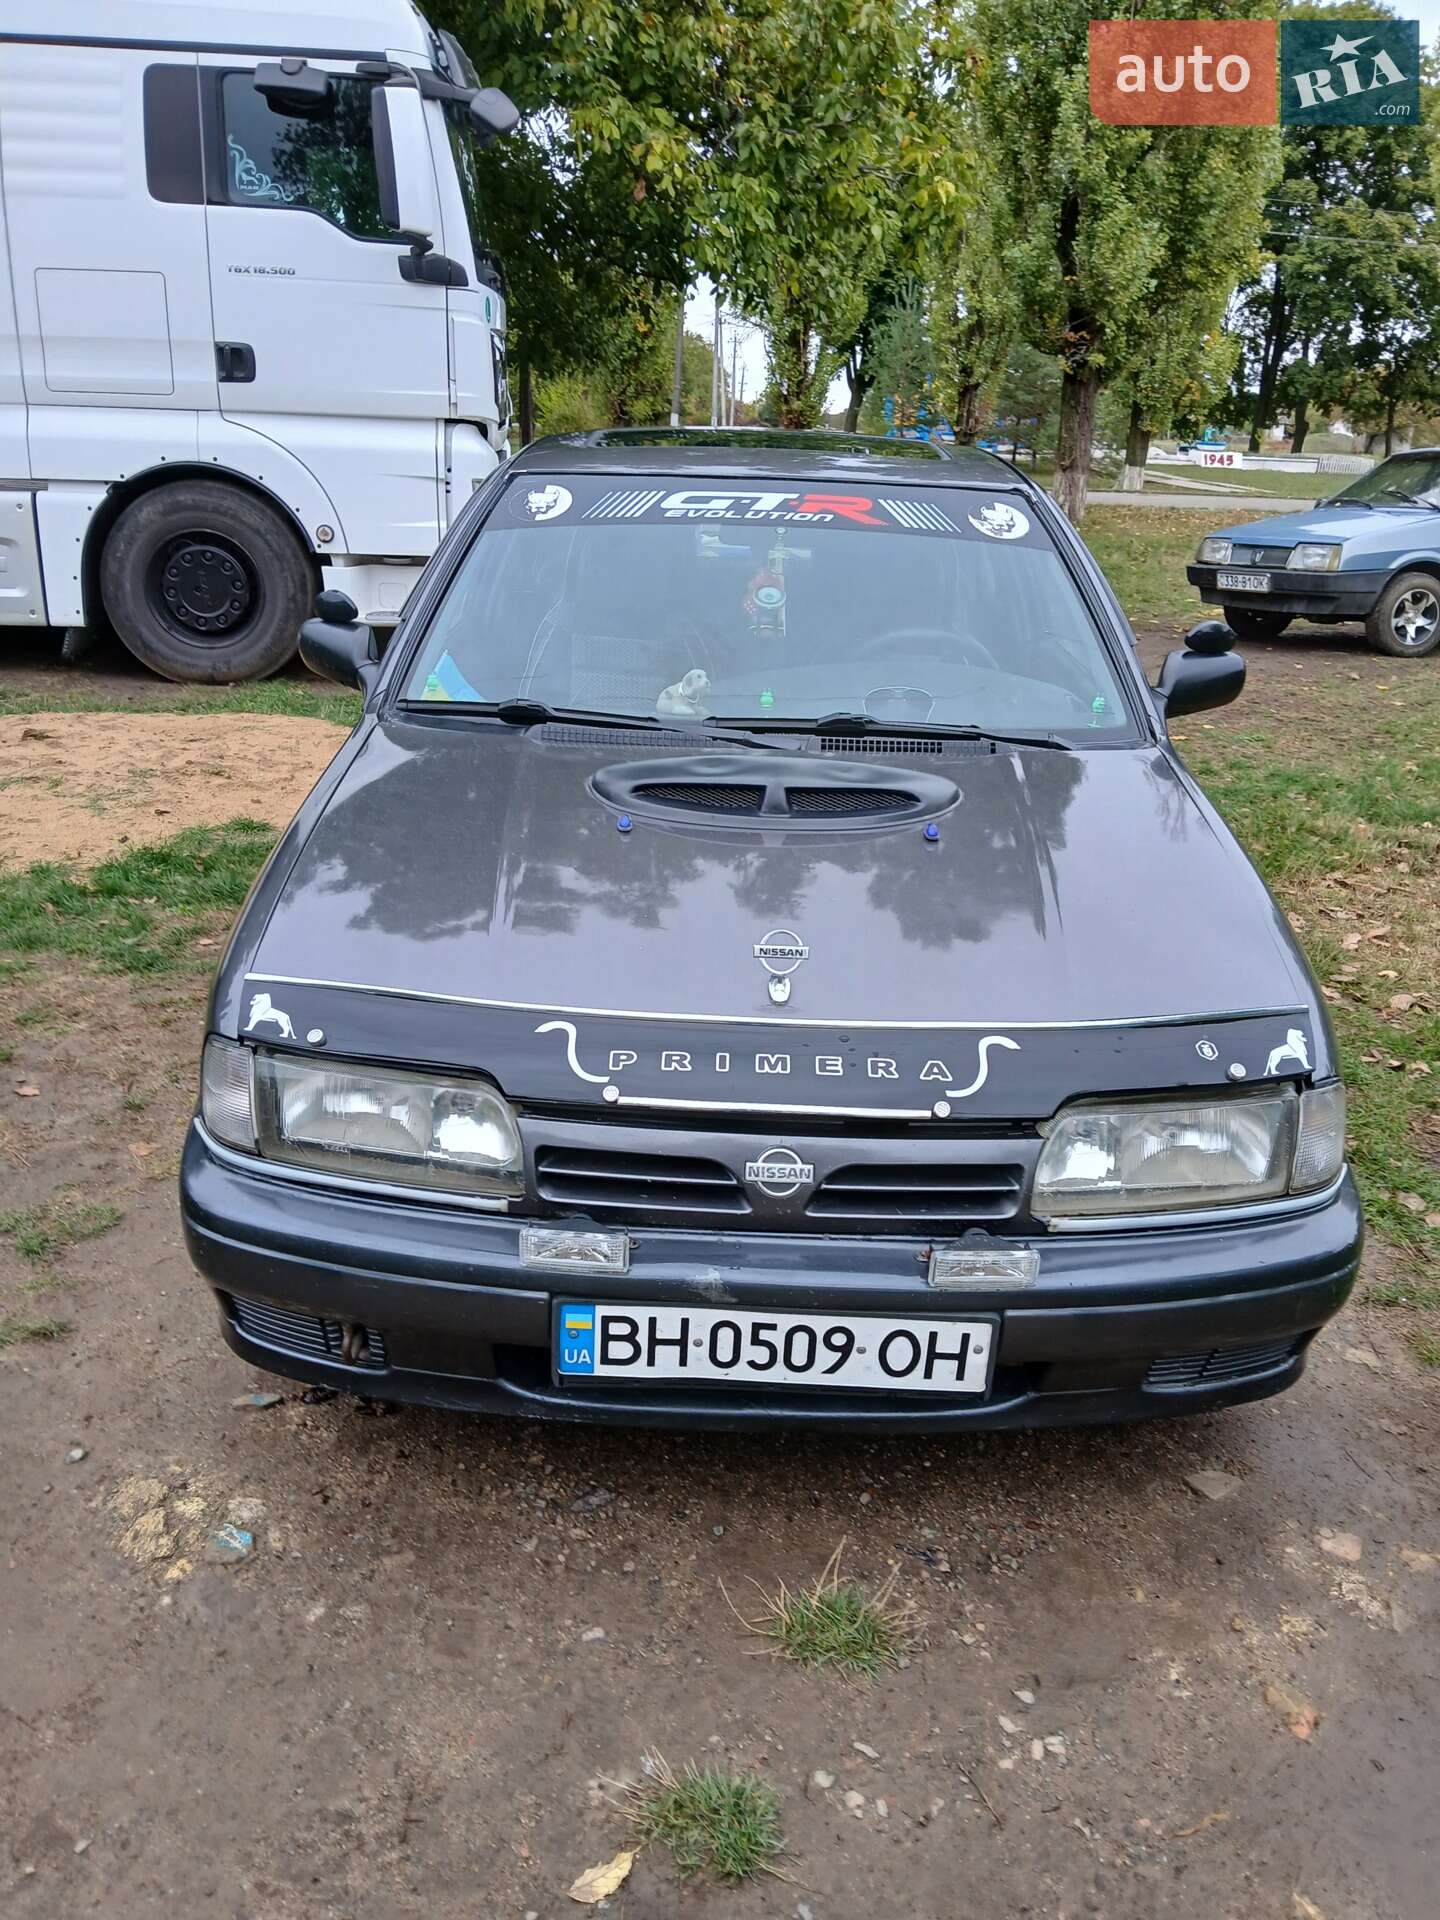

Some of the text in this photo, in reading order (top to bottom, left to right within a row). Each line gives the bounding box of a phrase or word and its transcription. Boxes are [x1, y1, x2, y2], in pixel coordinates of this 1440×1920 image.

[1204, 453, 1234, 467] 1945
[759, 947, 804, 957] NISSAN
[608, 1050, 953, 1081] PRIMERA
[747, 1166, 812, 1180] NISSAN
[564, 1347, 592, 1365] UA
[599, 1315, 972, 1382] BH 0509 OH
